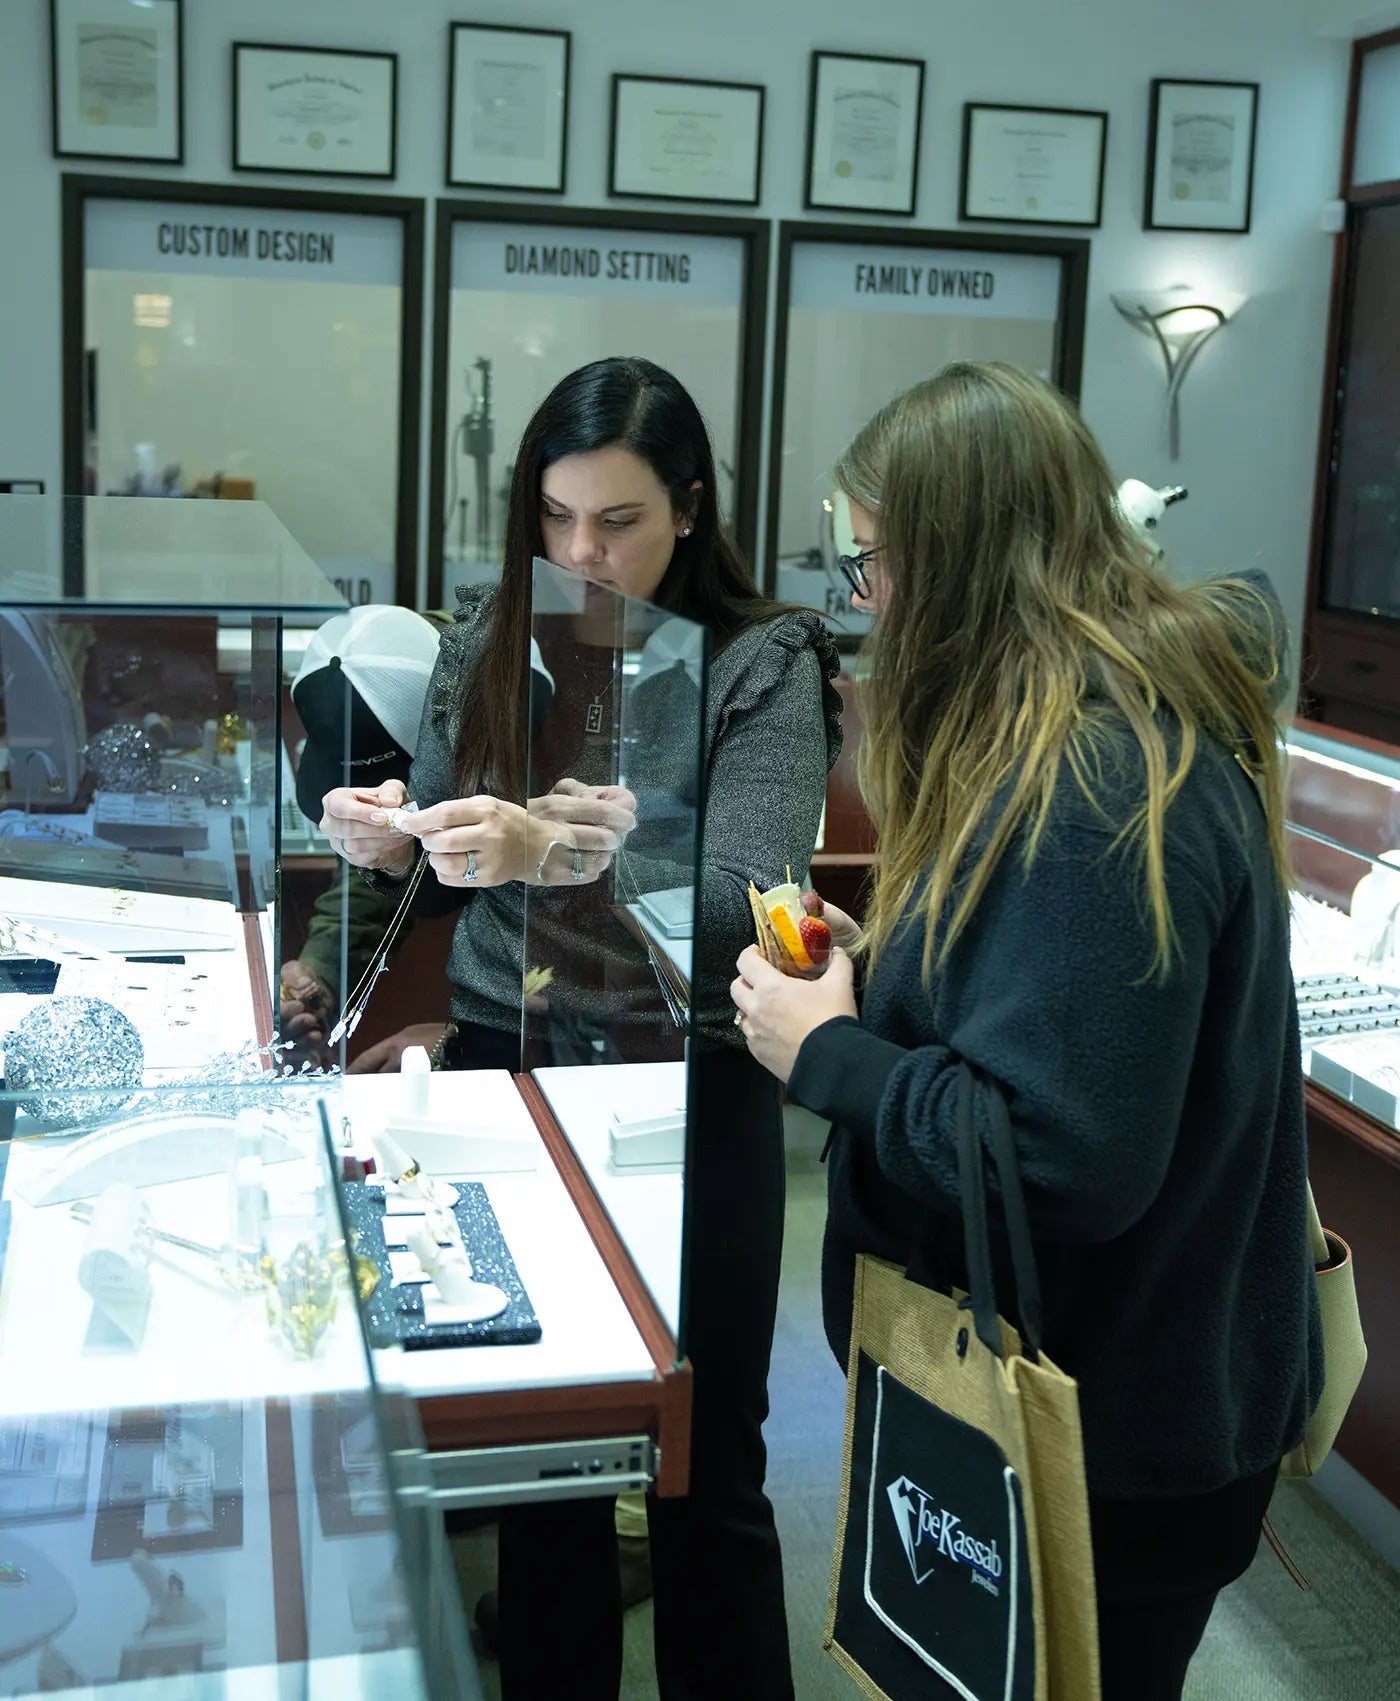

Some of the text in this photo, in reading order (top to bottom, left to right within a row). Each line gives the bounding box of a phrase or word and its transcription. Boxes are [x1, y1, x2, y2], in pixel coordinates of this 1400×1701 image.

[158, 223, 334, 264] CUSTOM DESIGN
[505, 244, 691, 284] DIAMOND SETTING
[855, 263, 994, 300] FAMILY OWNED
